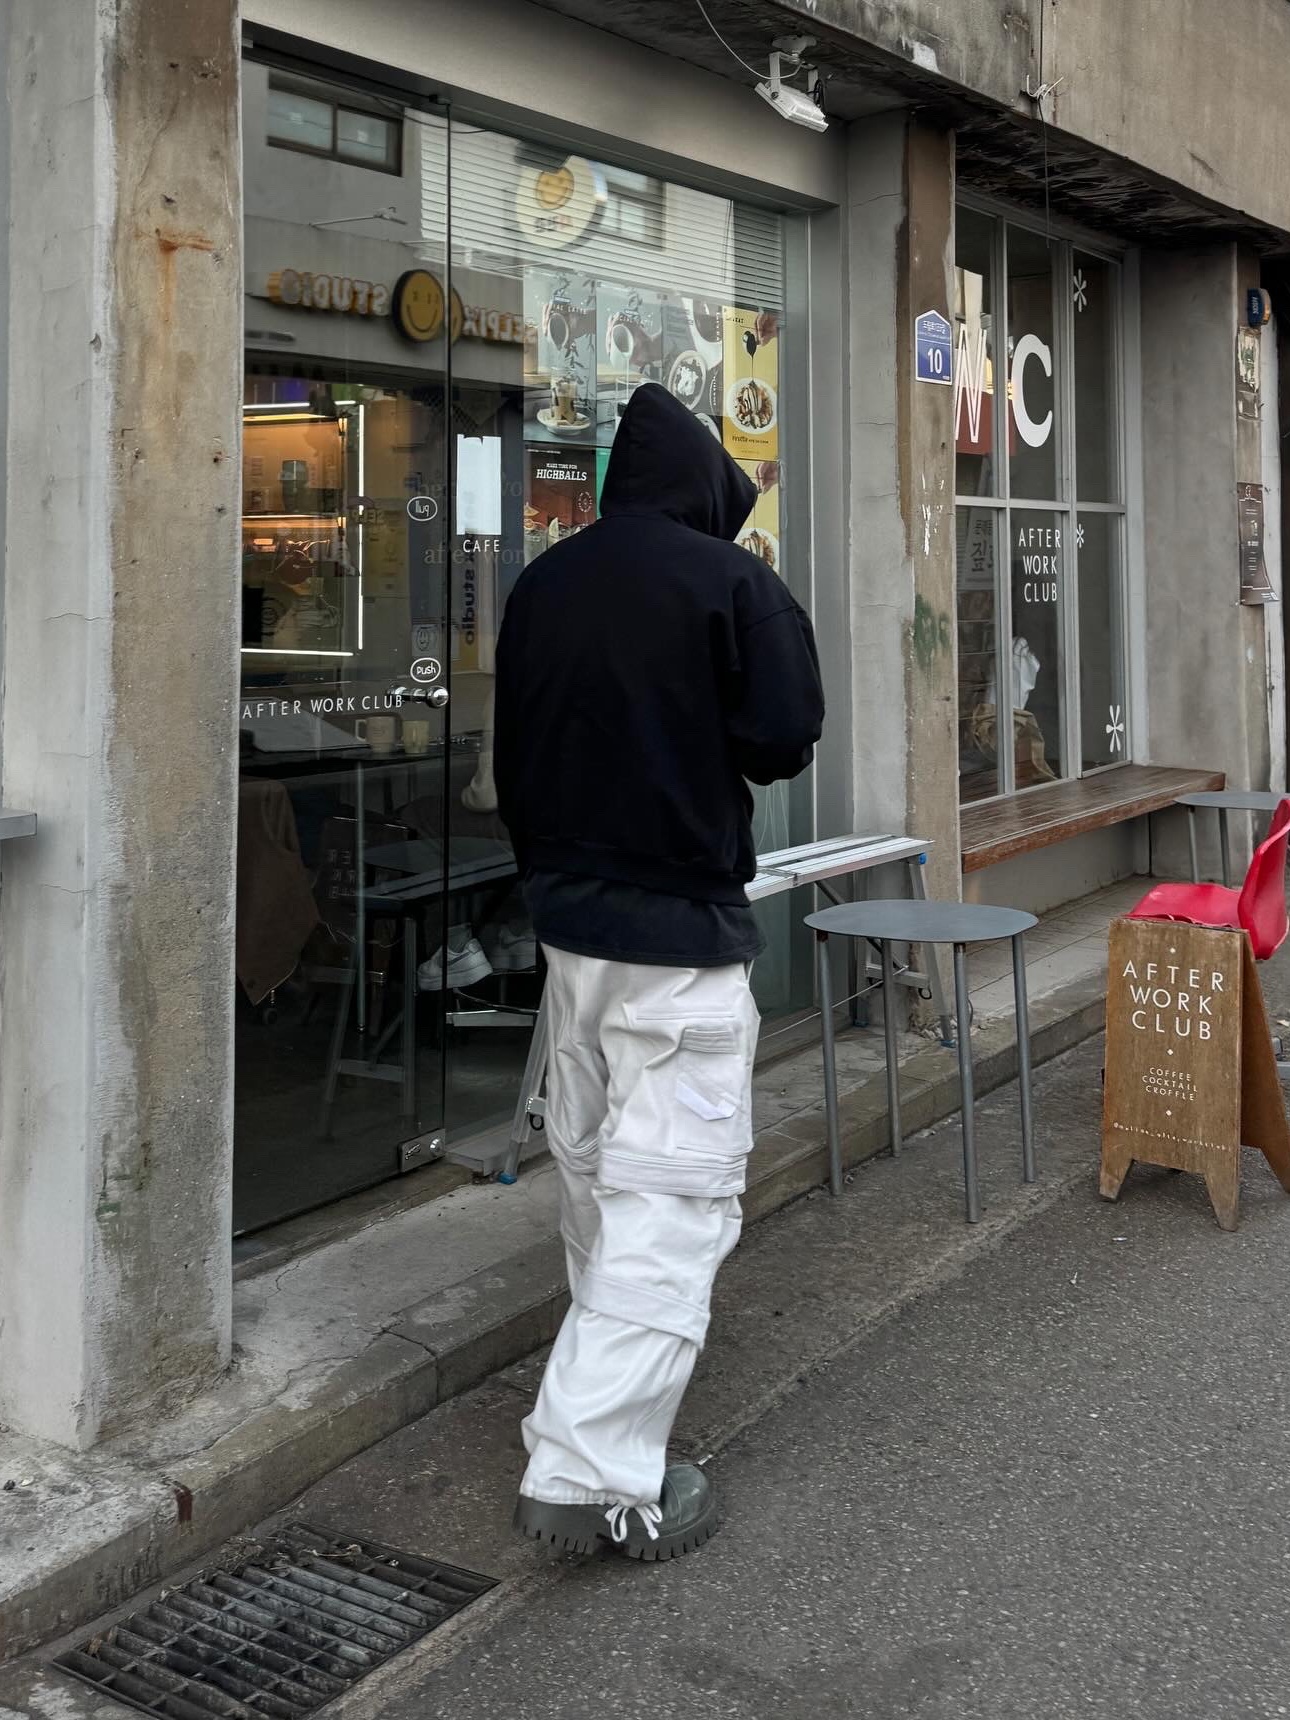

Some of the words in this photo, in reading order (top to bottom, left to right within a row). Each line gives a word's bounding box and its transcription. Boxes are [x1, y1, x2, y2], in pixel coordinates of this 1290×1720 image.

[927, 347, 943, 375] 10
[535, 468, 588, 482] HIGHBALLS
[462, 539, 501, 554] CAFE
[1018, 527, 1062, 548] AFTER
[1023, 554, 1059, 575] WORK
[1024, 582, 1059, 603] CLUB
[242, 700, 302, 719] AFTER
[310, 696, 356, 713] WORK
[361, 694, 403, 711] CLUB
[1122, 960, 1225, 992] AFTER
[1129, 984, 1213, 1016] WORK
[1131, 1010, 1212, 1040] CLUB
[1141, 1075, 1198, 1093] COCKTAIL
[1149, 1067, 1192, 1082] COFFEE
[1145, 1084, 1195, 1101] CROFFLE
